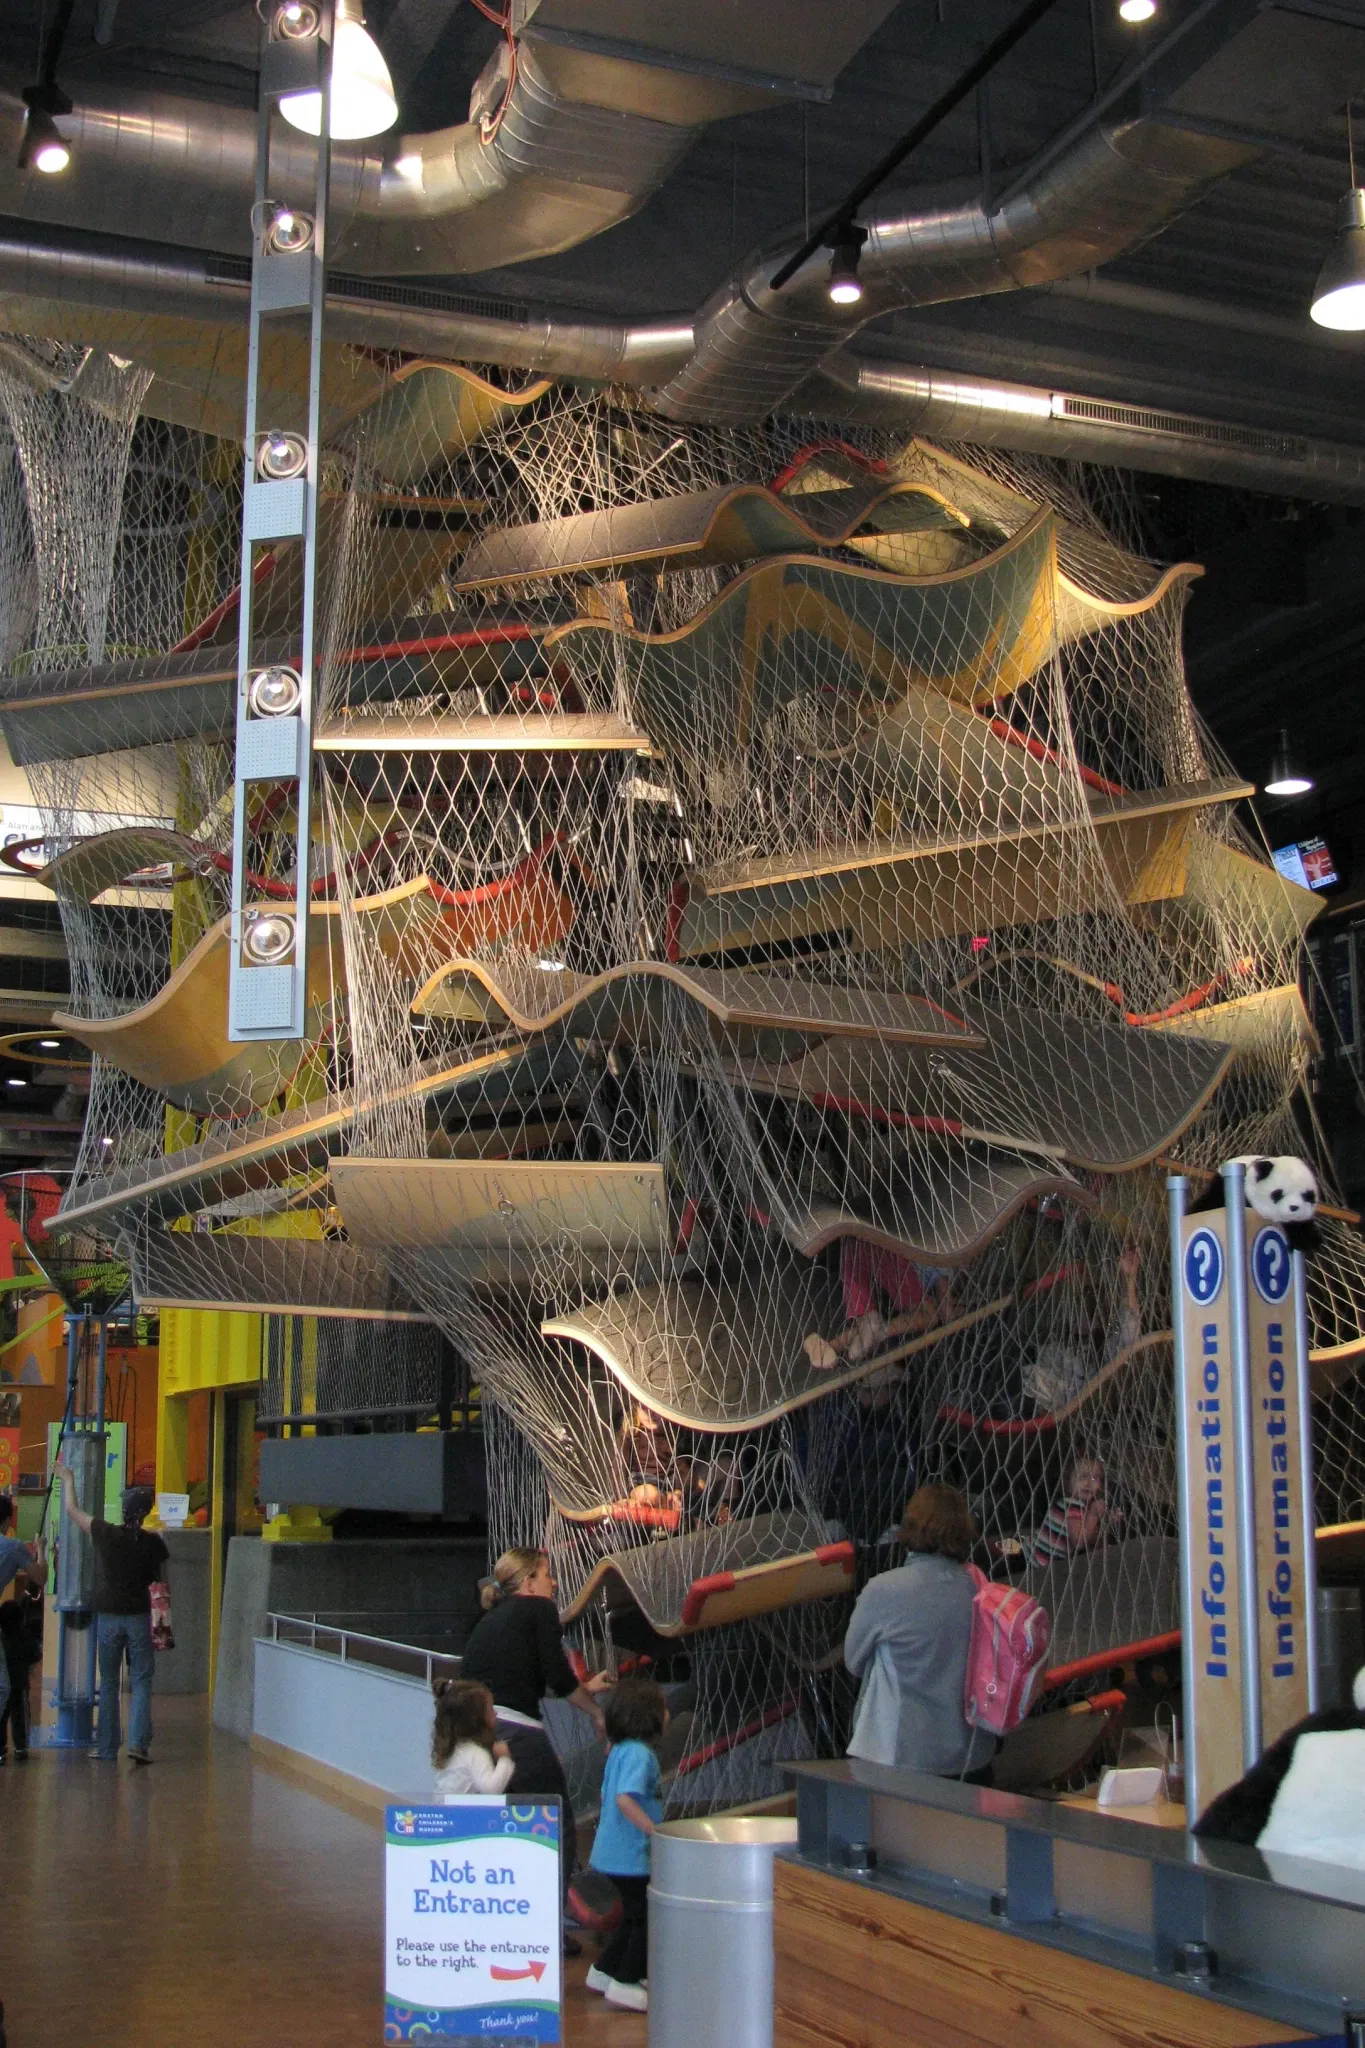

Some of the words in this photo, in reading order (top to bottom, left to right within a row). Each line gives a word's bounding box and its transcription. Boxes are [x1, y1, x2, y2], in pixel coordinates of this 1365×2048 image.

[1197, 1323, 1228, 1678] Information
[1262, 1323, 1293, 1678] Information
[430, 1859, 476, 1884] Not
[485, 1868, 515, 1885] an
[413, 1889, 531, 1915] Entrance
[396, 1938, 435, 1952] Please
[439, 1942, 460, 1952] use
[464, 1939, 486, 1952] the
[490, 1941, 550, 1954] entrance
[396, 1954, 411, 1967] to
[415, 1954, 437, 1967] the
[442, 1955, 479, 1973] right.
[479, 2012, 513, 2029] Thank
[514, 2011, 539, 2031] you!
